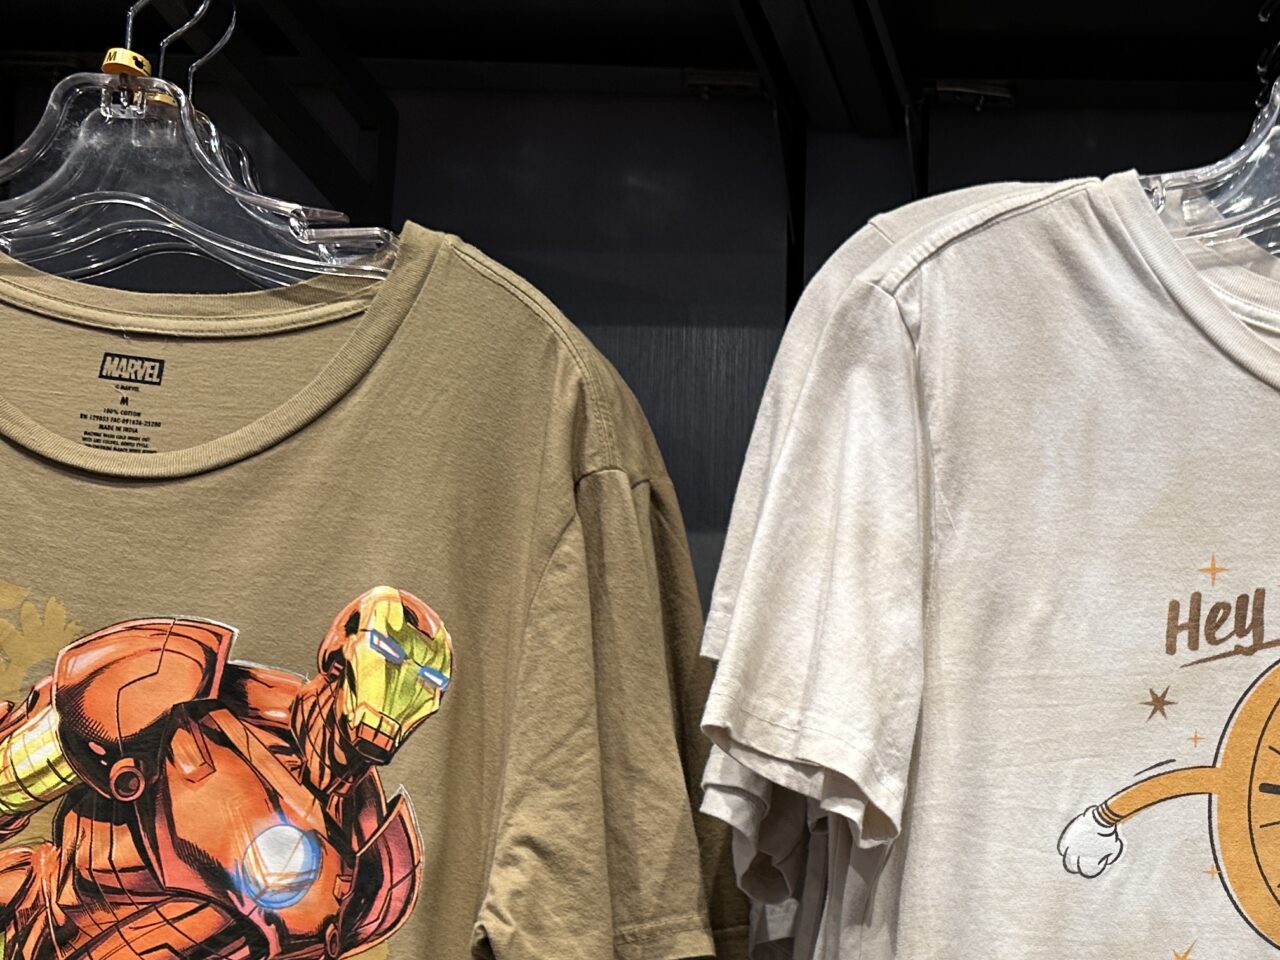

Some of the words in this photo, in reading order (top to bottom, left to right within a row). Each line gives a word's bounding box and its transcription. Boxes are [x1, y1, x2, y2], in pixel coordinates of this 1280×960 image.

[106, 51, 117, 62] M
[101, 355, 161, 383] MARVEL
[120, 397, 128, 406] M
[1165, 587, 1266, 656] Hey
